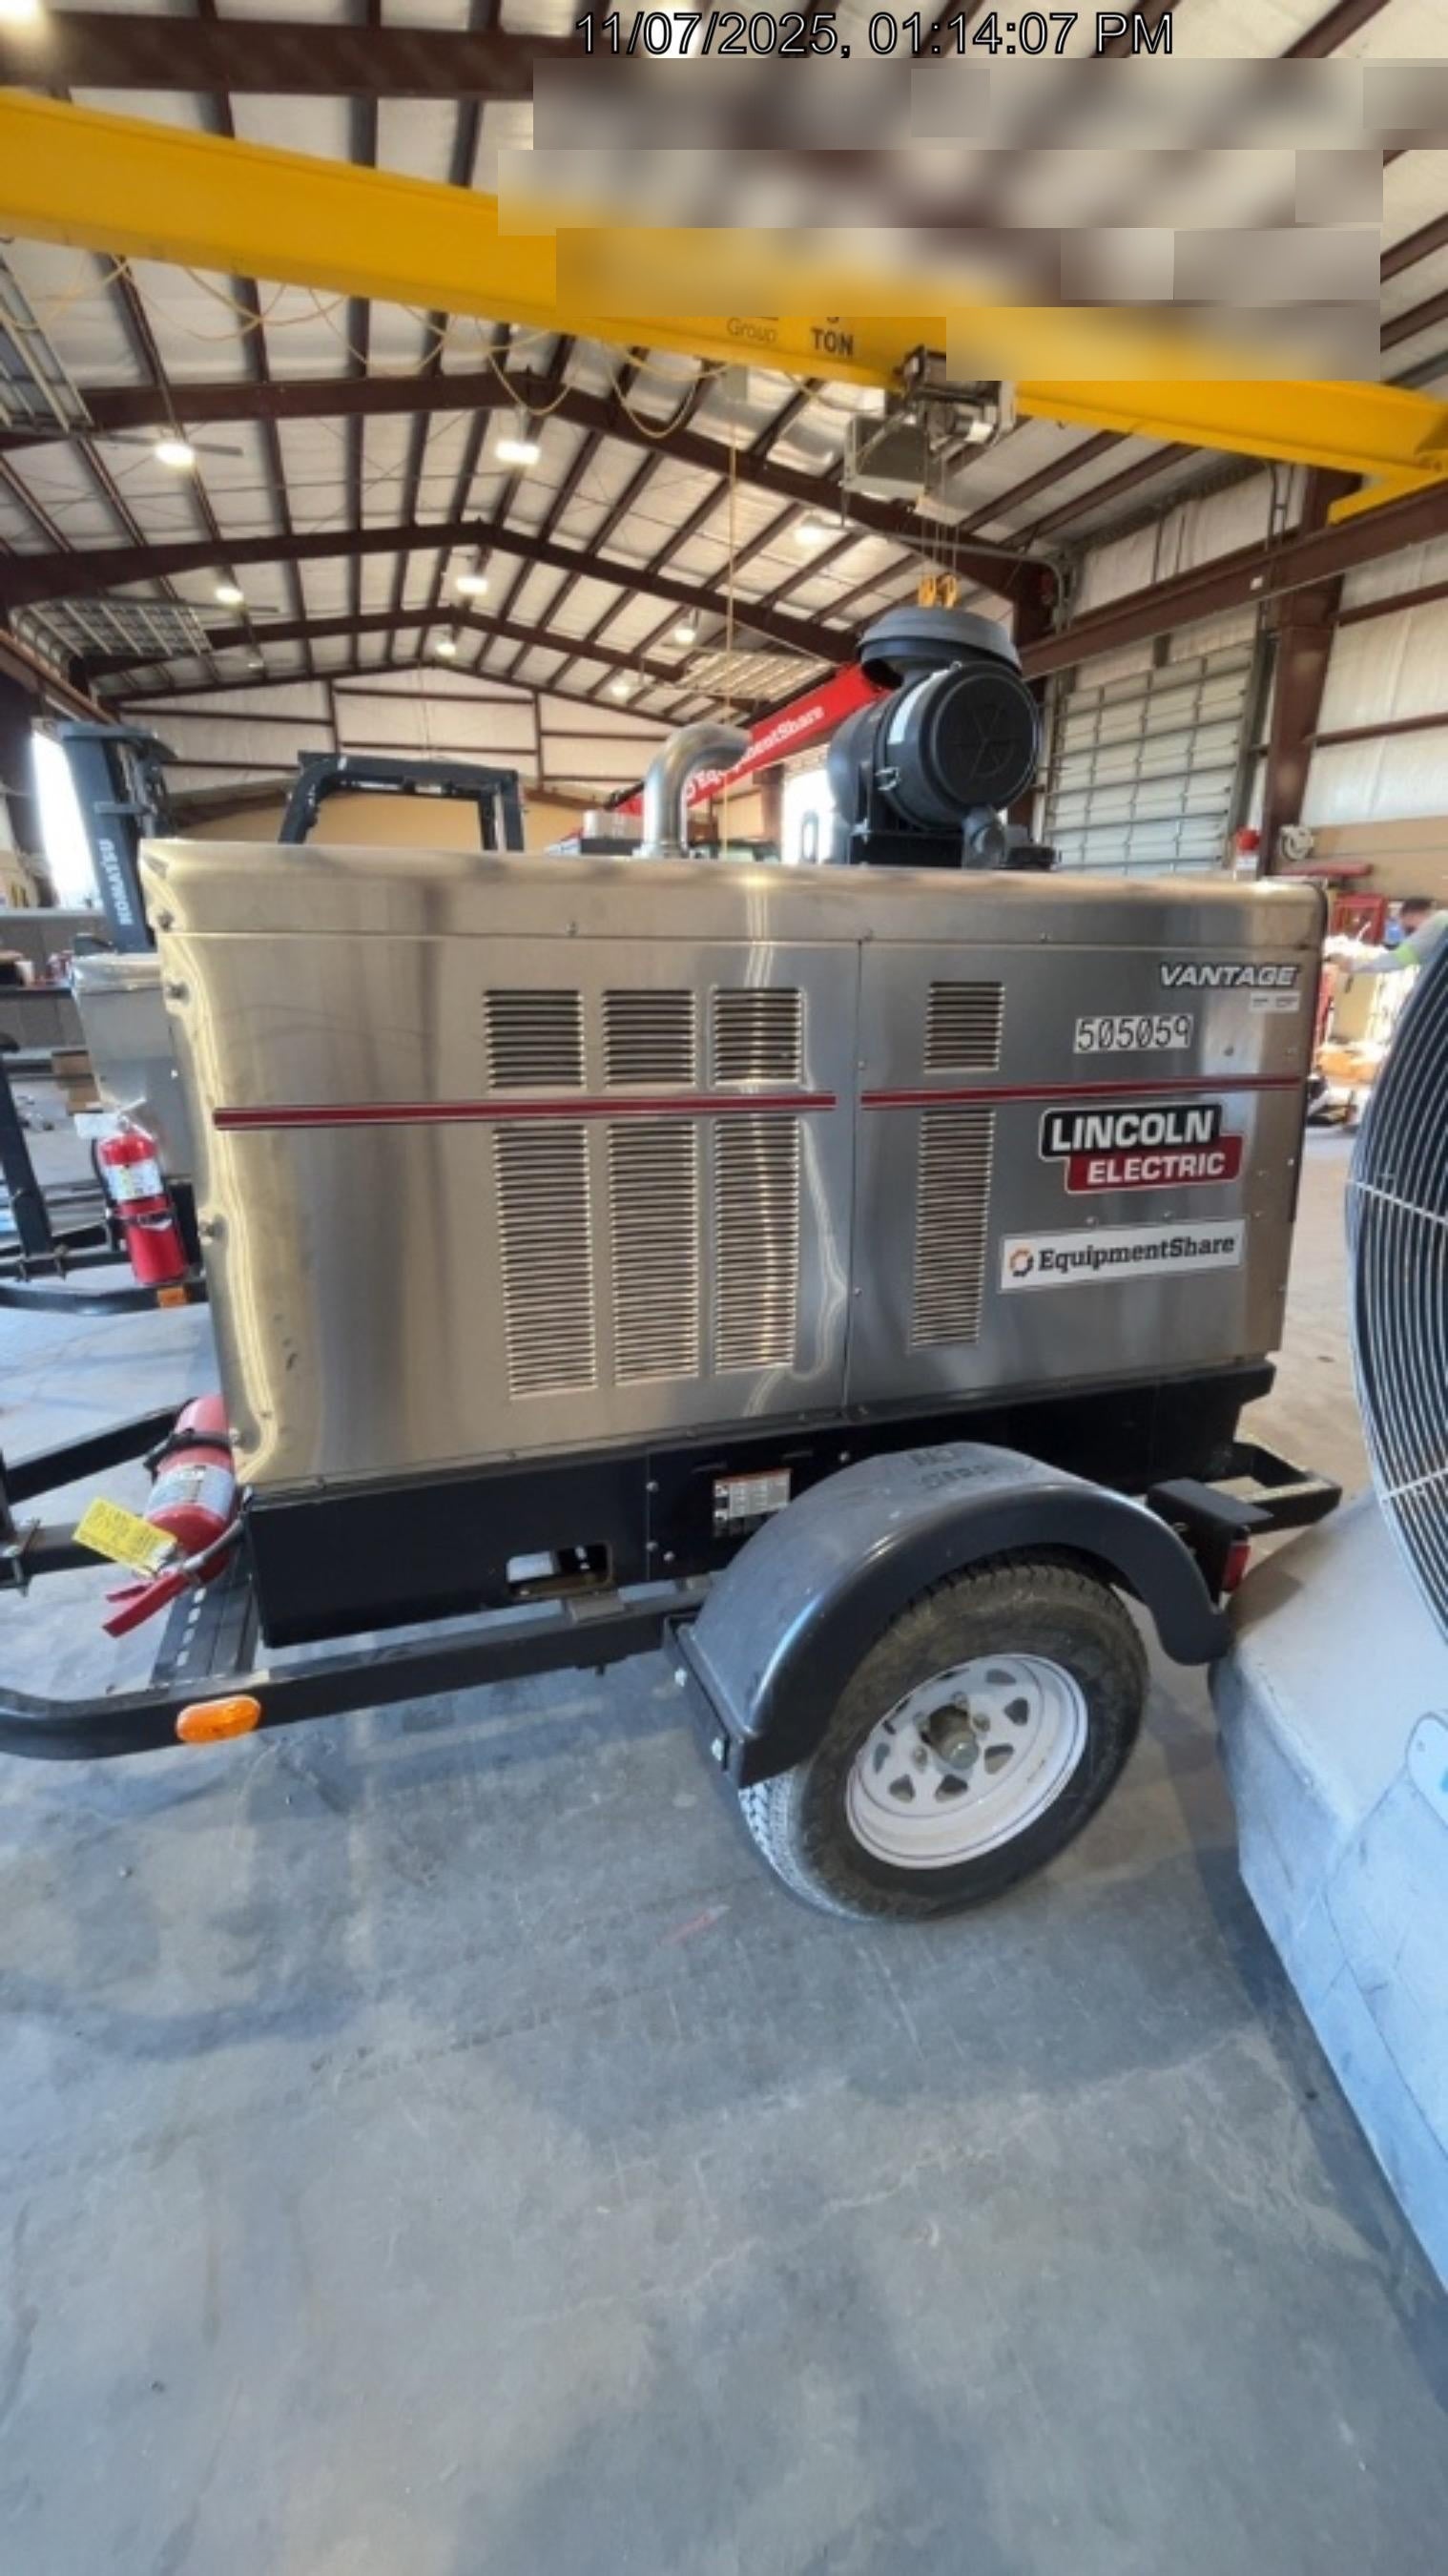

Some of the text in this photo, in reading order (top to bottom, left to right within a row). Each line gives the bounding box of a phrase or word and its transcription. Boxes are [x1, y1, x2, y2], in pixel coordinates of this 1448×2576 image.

[811, 325, 856, 357] TON
[98, 838, 134, 926] KOMATSU
[1160, 965, 1298, 987] VANTAGE
[1077, 1014, 1191, 1050] 505059
[1050, 1109, 1215, 1152] LINCOLN
[1086, 1152, 1227, 1185] ELECTRIC
[1038, 1236, 1235, 1275] EquipmentShare
